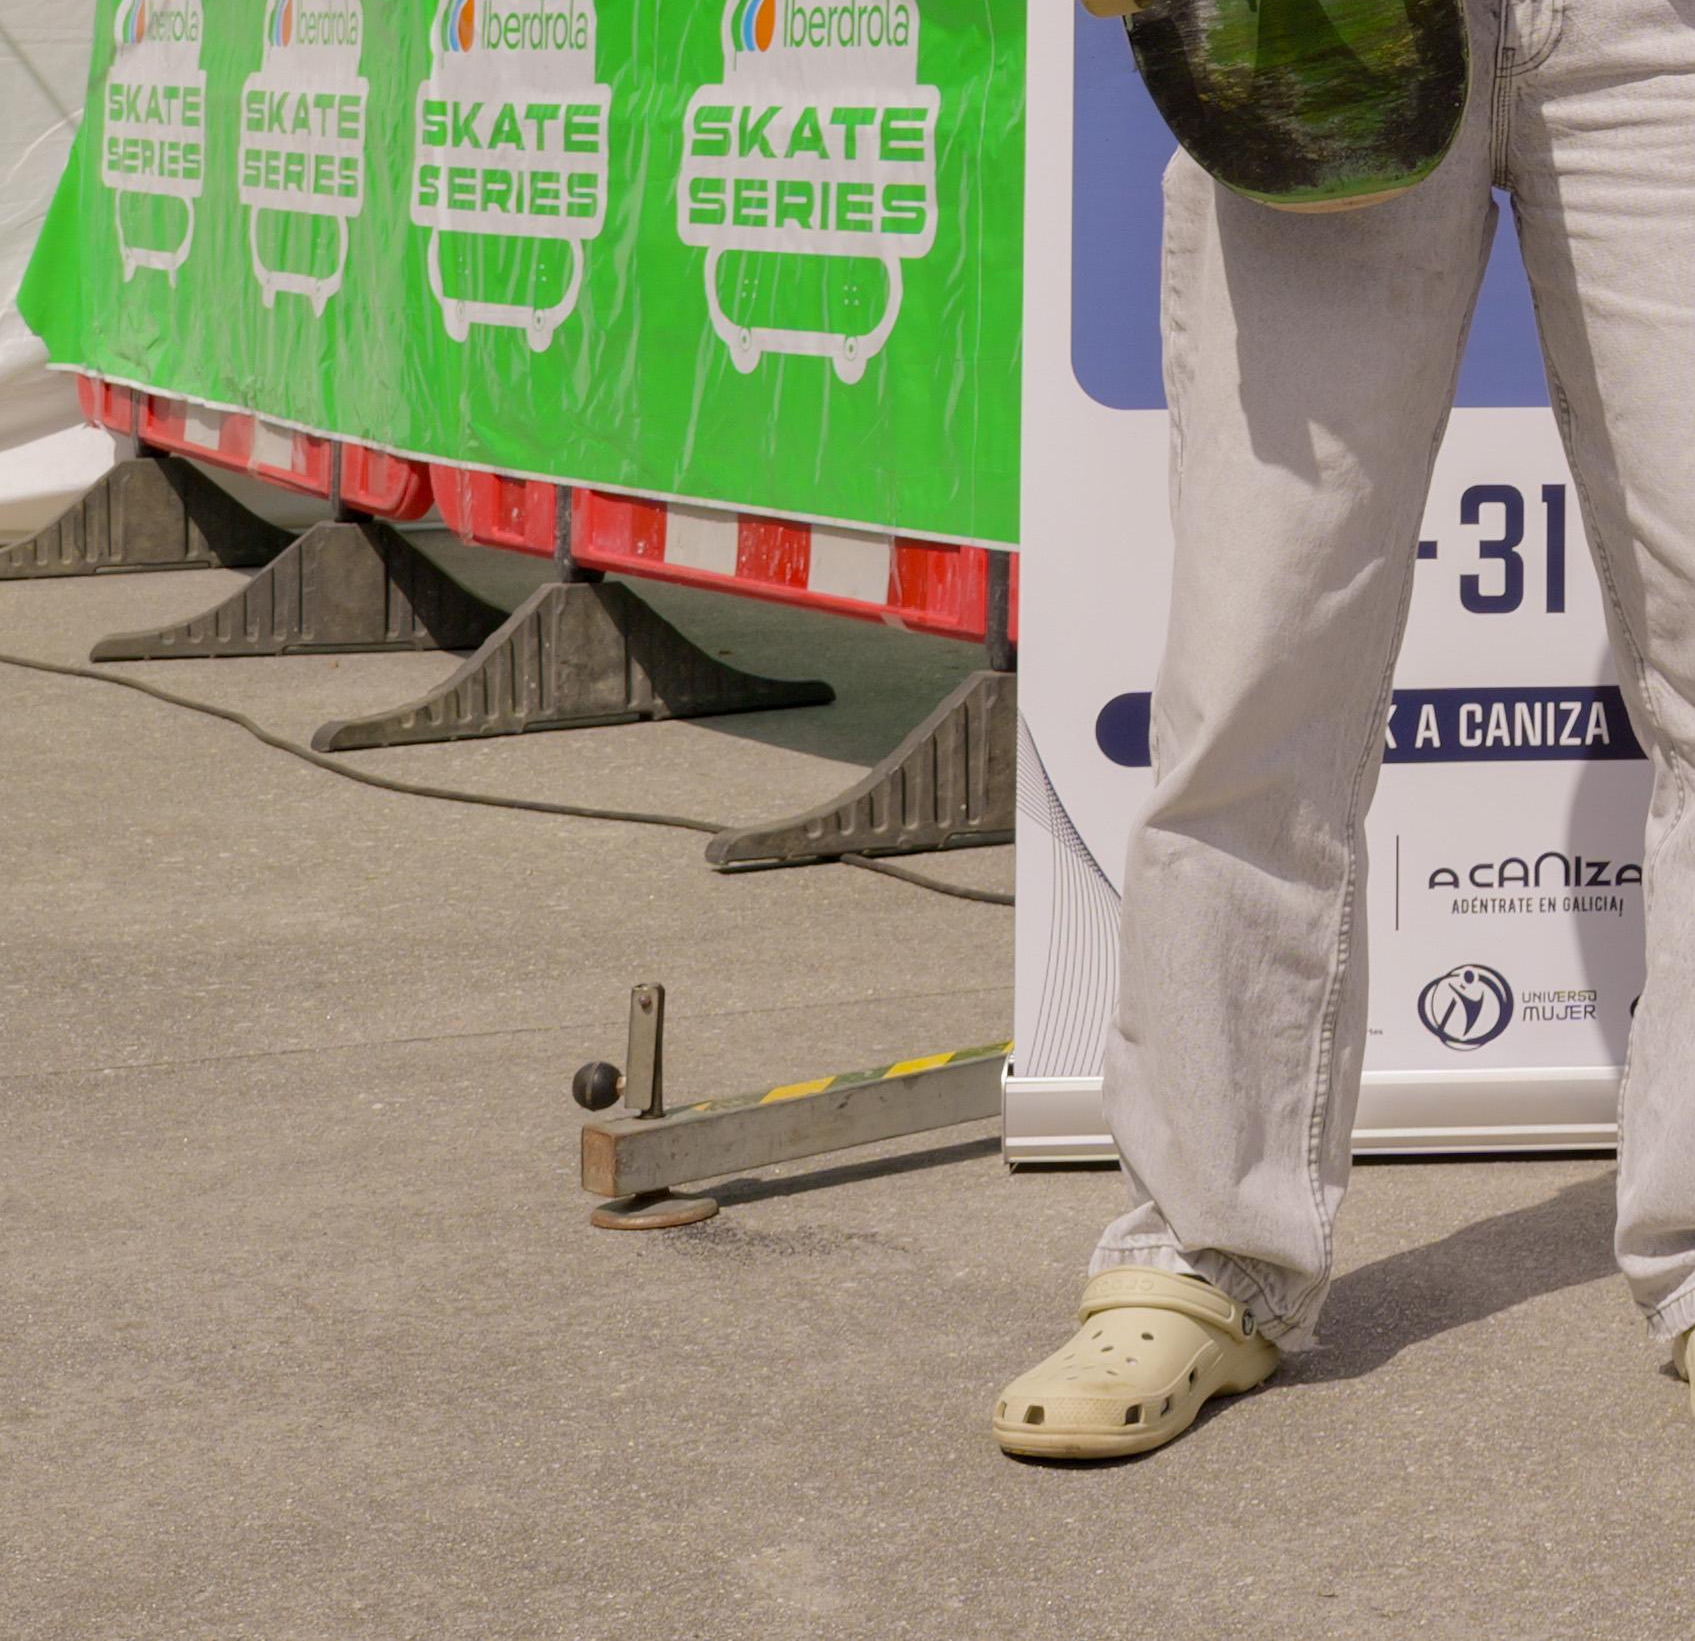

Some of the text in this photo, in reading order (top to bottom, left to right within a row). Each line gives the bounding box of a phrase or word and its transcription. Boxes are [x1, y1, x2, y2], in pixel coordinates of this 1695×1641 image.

[109, 83, 201, 127] SKATE
[246, 89, 362, 139] SKATE
[422, 99, 602, 154] SKATE
[107, 136, 201, 180] SERIES
[691, 106, 929, 162] SKATE
[243, 148, 359, 198] SERIES
[418, 164, 599, 218] SERIES
[689, 177, 927, 235] SERIES
[1414, 703, 1441, 749] A
[1458, 701, 1611, 747] CANIZA
[1428, 851, 1643, 889] A CANIZA
[1452, 895, 1534, 915] ADÉNTRATE
[1539, 896, 1557, 912] EN
[1521, 989, 1597, 1004] UNIVERSO
[1522, 1004, 1598, 1022] MUJER
